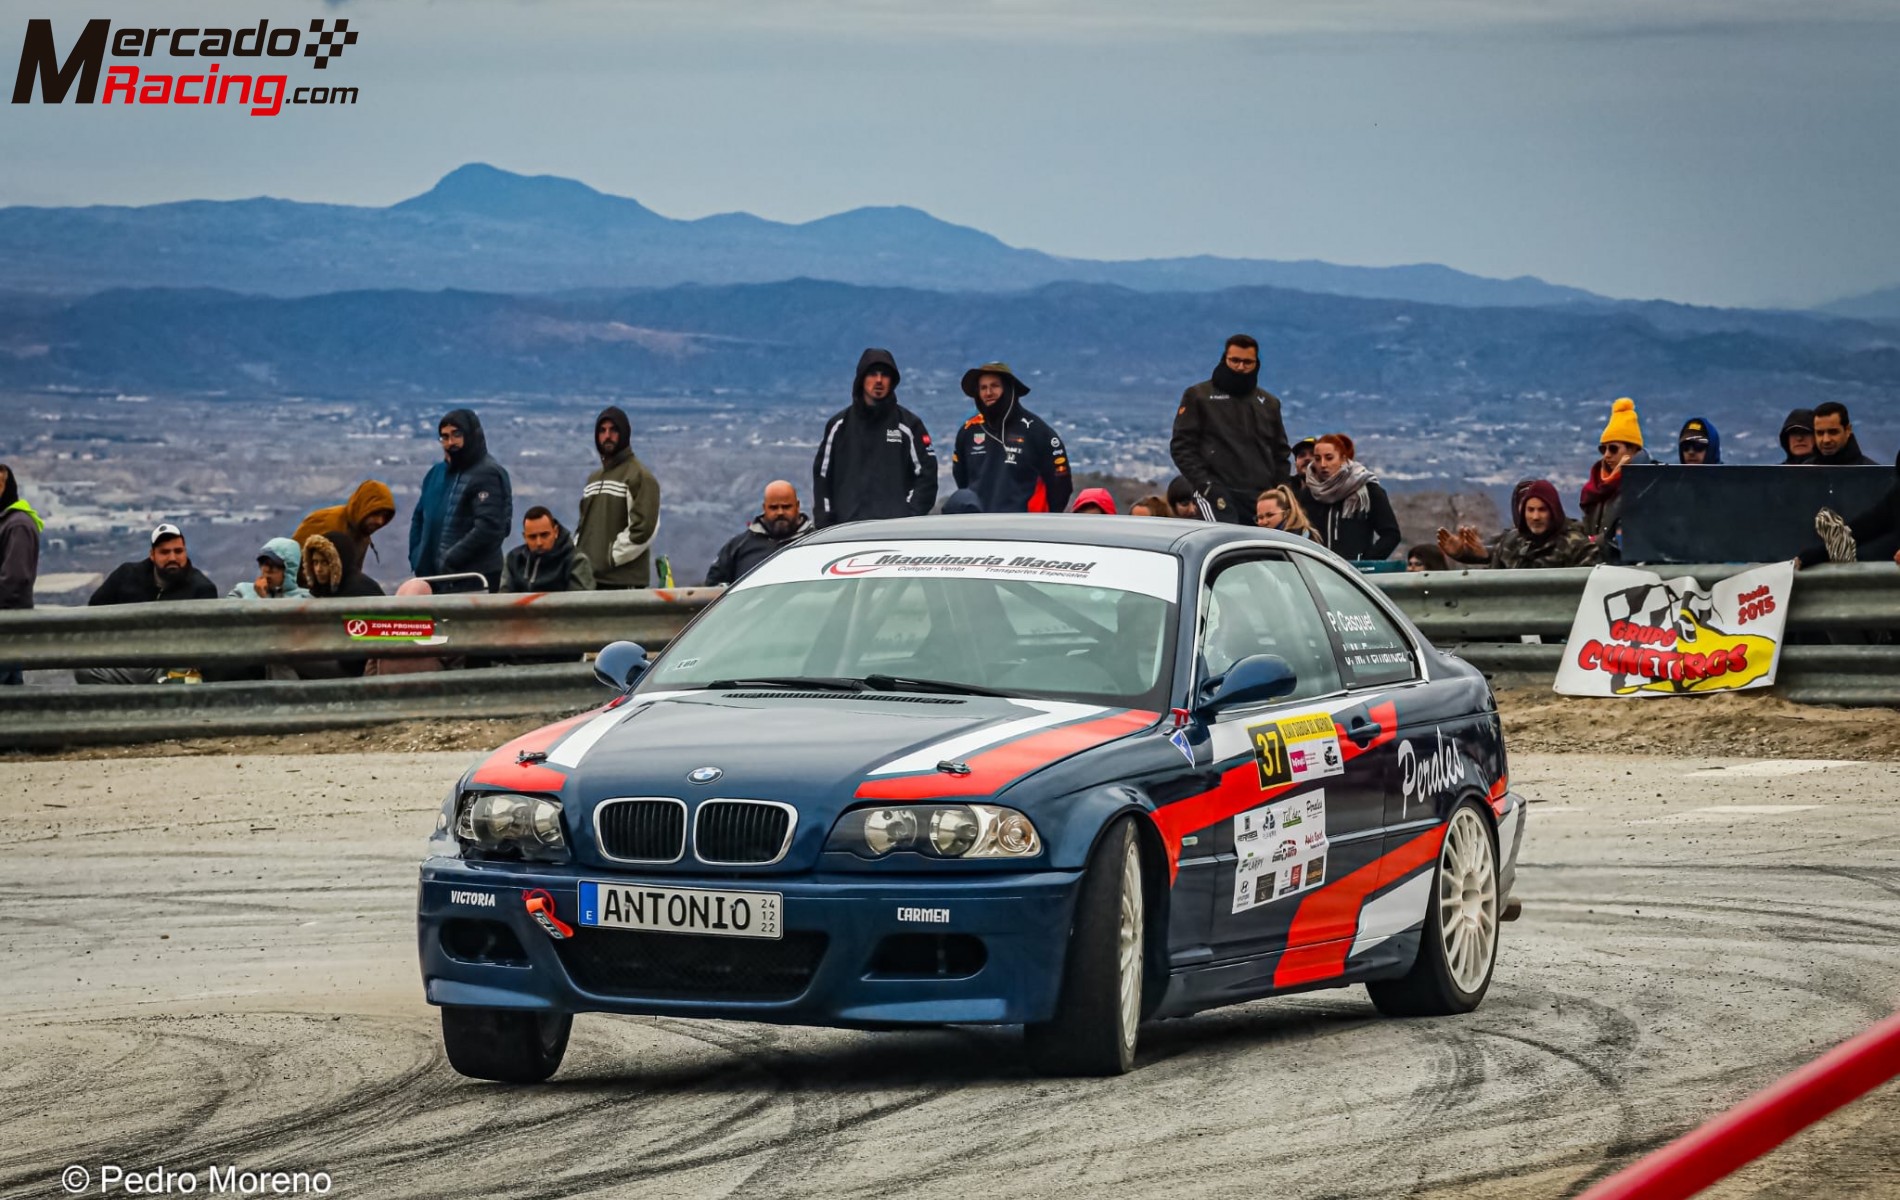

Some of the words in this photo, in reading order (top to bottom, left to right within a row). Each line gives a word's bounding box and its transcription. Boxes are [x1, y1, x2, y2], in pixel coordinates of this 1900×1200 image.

[875, 554, 1005, 566] Maquinaria
[1008, 556, 1097, 571] Macael
[1738, 595, 1776, 625] 2015
[1610, 619, 1678, 647] GRUPO
[1256, 730, 1282, 777] 37
[1398, 725, 1464, 819] Perales
[451, 890, 496, 907] VICTORIA
[760, 899, 775, 909] 24
[585, 910, 593, 920] E
[604, 889, 751, 930] ANTONIO
[761, 911, 775, 921] 12
[897, 907, 950, 923] CARMEN
[760, 923, 776, 933] 22
